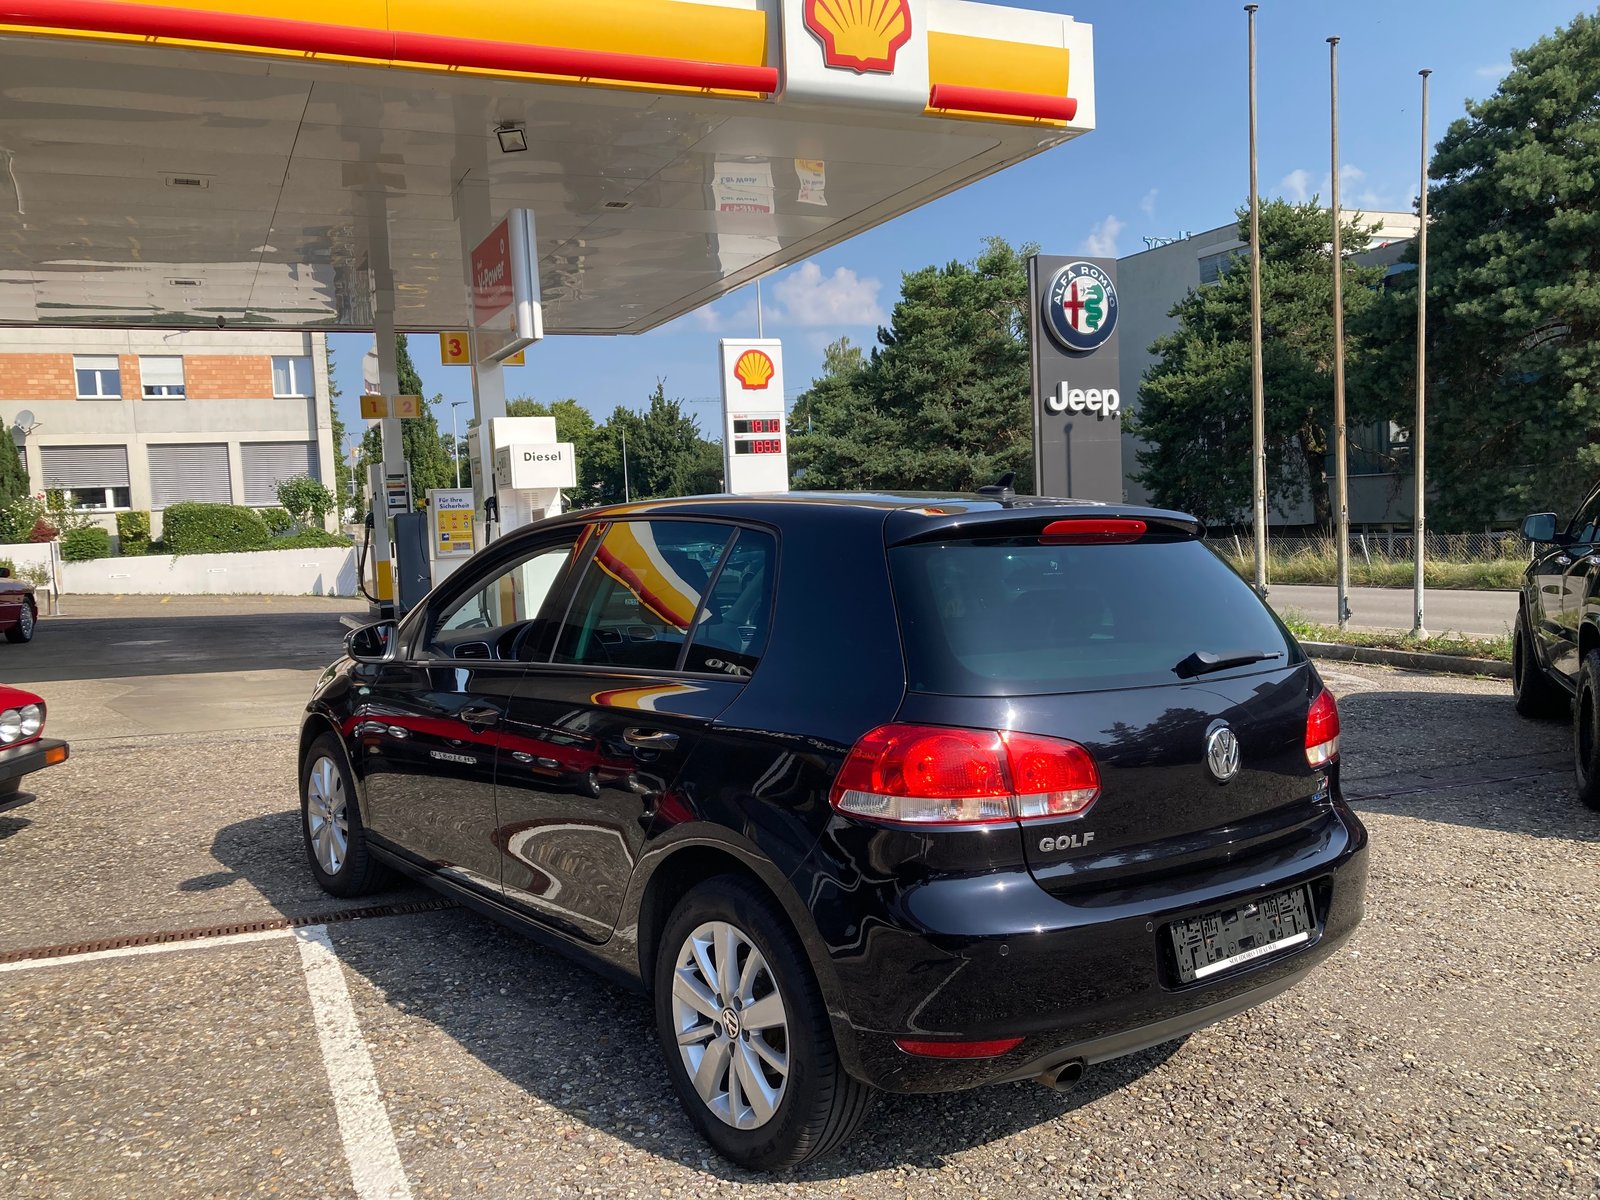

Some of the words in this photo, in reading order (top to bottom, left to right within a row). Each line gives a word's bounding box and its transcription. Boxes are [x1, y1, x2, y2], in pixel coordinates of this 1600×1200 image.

[478, 260, 504, 294] V-Power
[1053, 269, 1077, 306] ALFA
[1081, 266, 1116, 308] ROMEO
[448, 338, 462, 357] 3
[370, 402, 377, 413] 1
[402, 402, 413, 413] 2
[1049, 381, 1120, 416] Jeep
[523, 451, 562, 462] Diesel
[1038, 831, 1095, 853] GOLF
